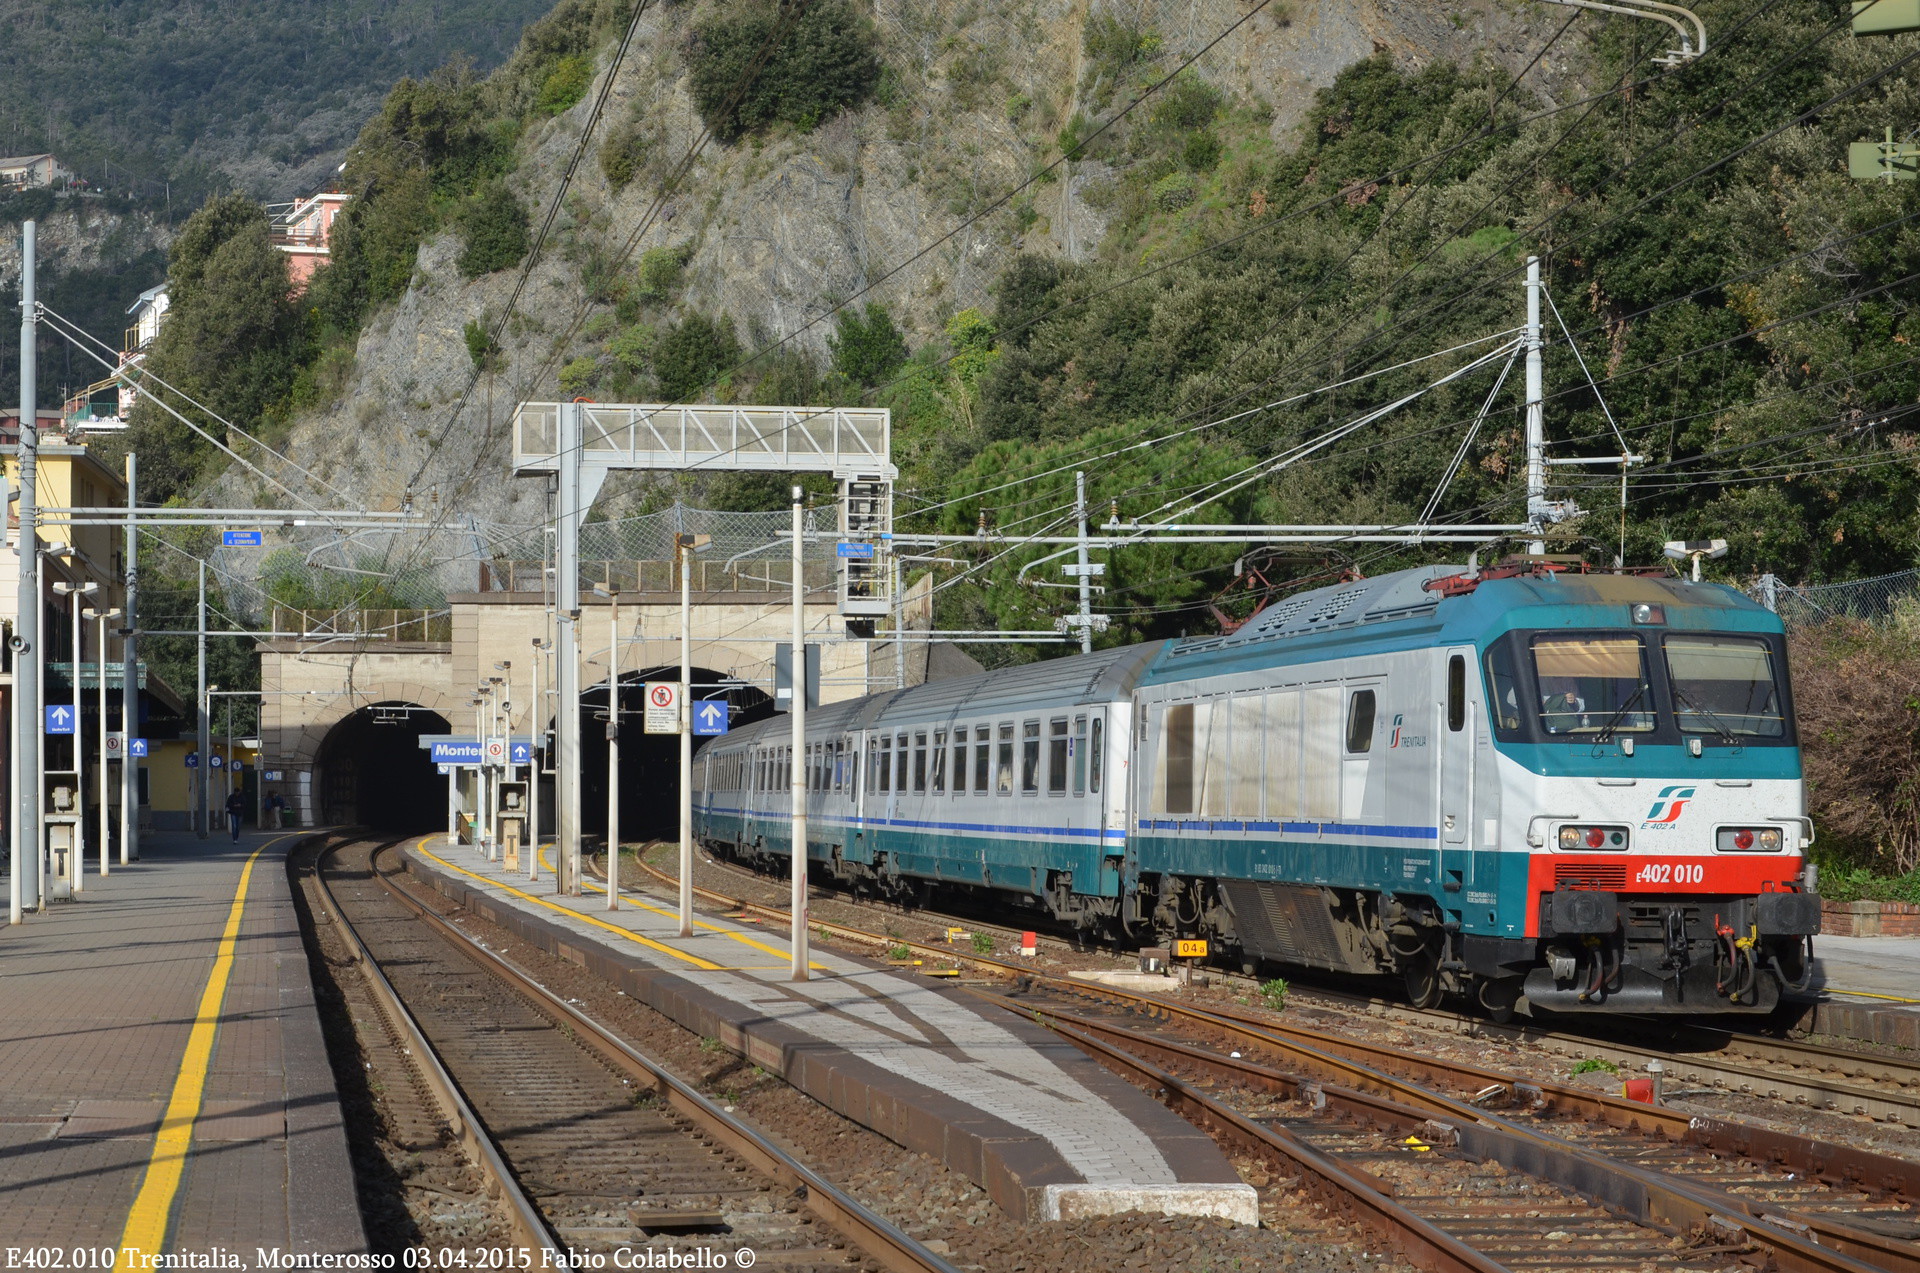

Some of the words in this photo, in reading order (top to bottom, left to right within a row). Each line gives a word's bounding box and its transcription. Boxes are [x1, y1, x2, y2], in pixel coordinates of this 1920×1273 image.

[1401, 736, 1427, 747] TRENITALIA
[1640, 822, 1649, 830] E
[1636, 864, 1671, 883] E402
[1674, 864, 1704, 883] 010
